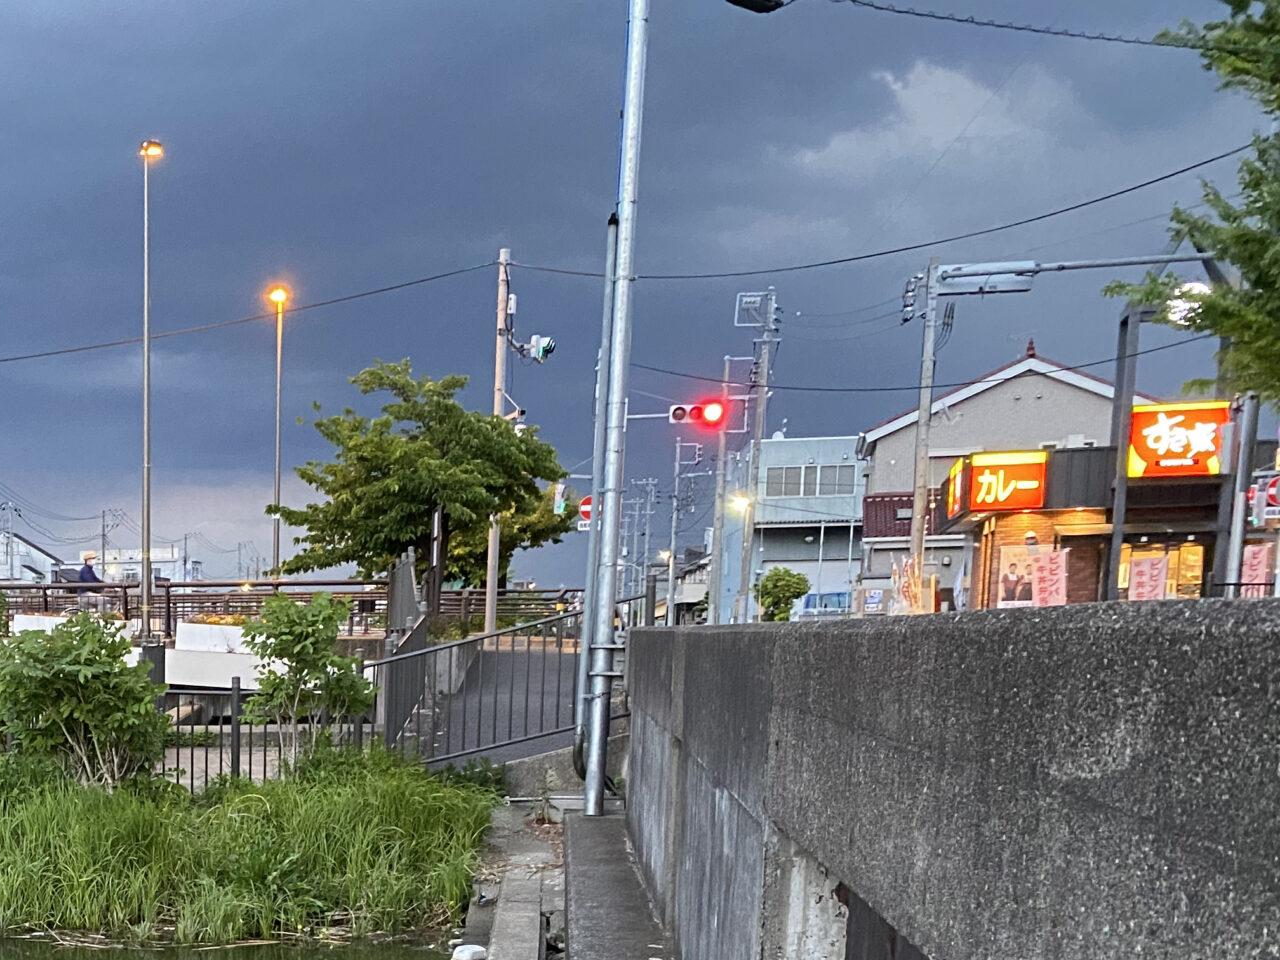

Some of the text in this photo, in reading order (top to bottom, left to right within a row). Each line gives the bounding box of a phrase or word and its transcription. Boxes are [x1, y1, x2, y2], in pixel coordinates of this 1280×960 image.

[1142, 412, 1217, 459] すき家
[976, 469, 1039, 504] カレー
